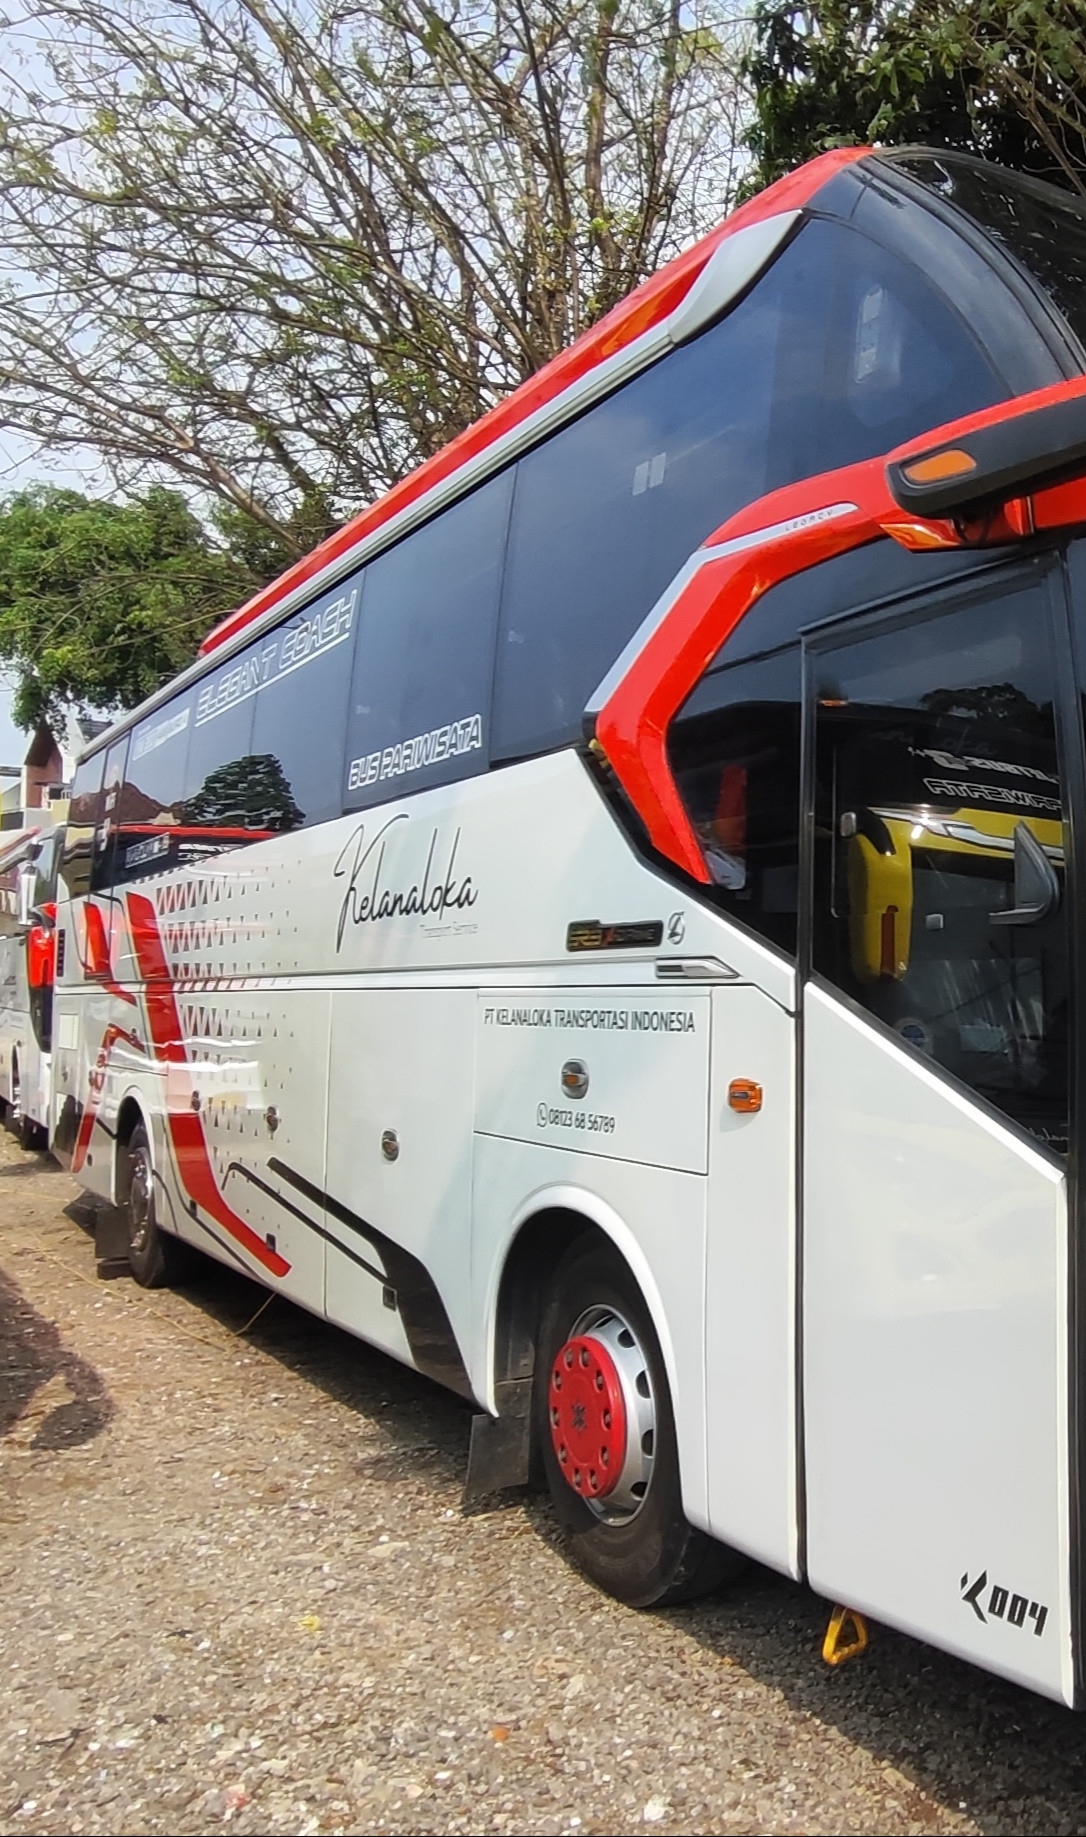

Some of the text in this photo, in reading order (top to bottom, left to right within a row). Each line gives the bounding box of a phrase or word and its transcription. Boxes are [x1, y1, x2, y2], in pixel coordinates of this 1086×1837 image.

[348, 714, 482, 790] BUS PARIWISATA
[334, 814, 478, 953] Kelanaloka
[484, 1009, 695, 1032] PT KELANALOKA TRANSPORTASI INDONESIA
[549, 1108, 615, 1134] 08123 68 56789
